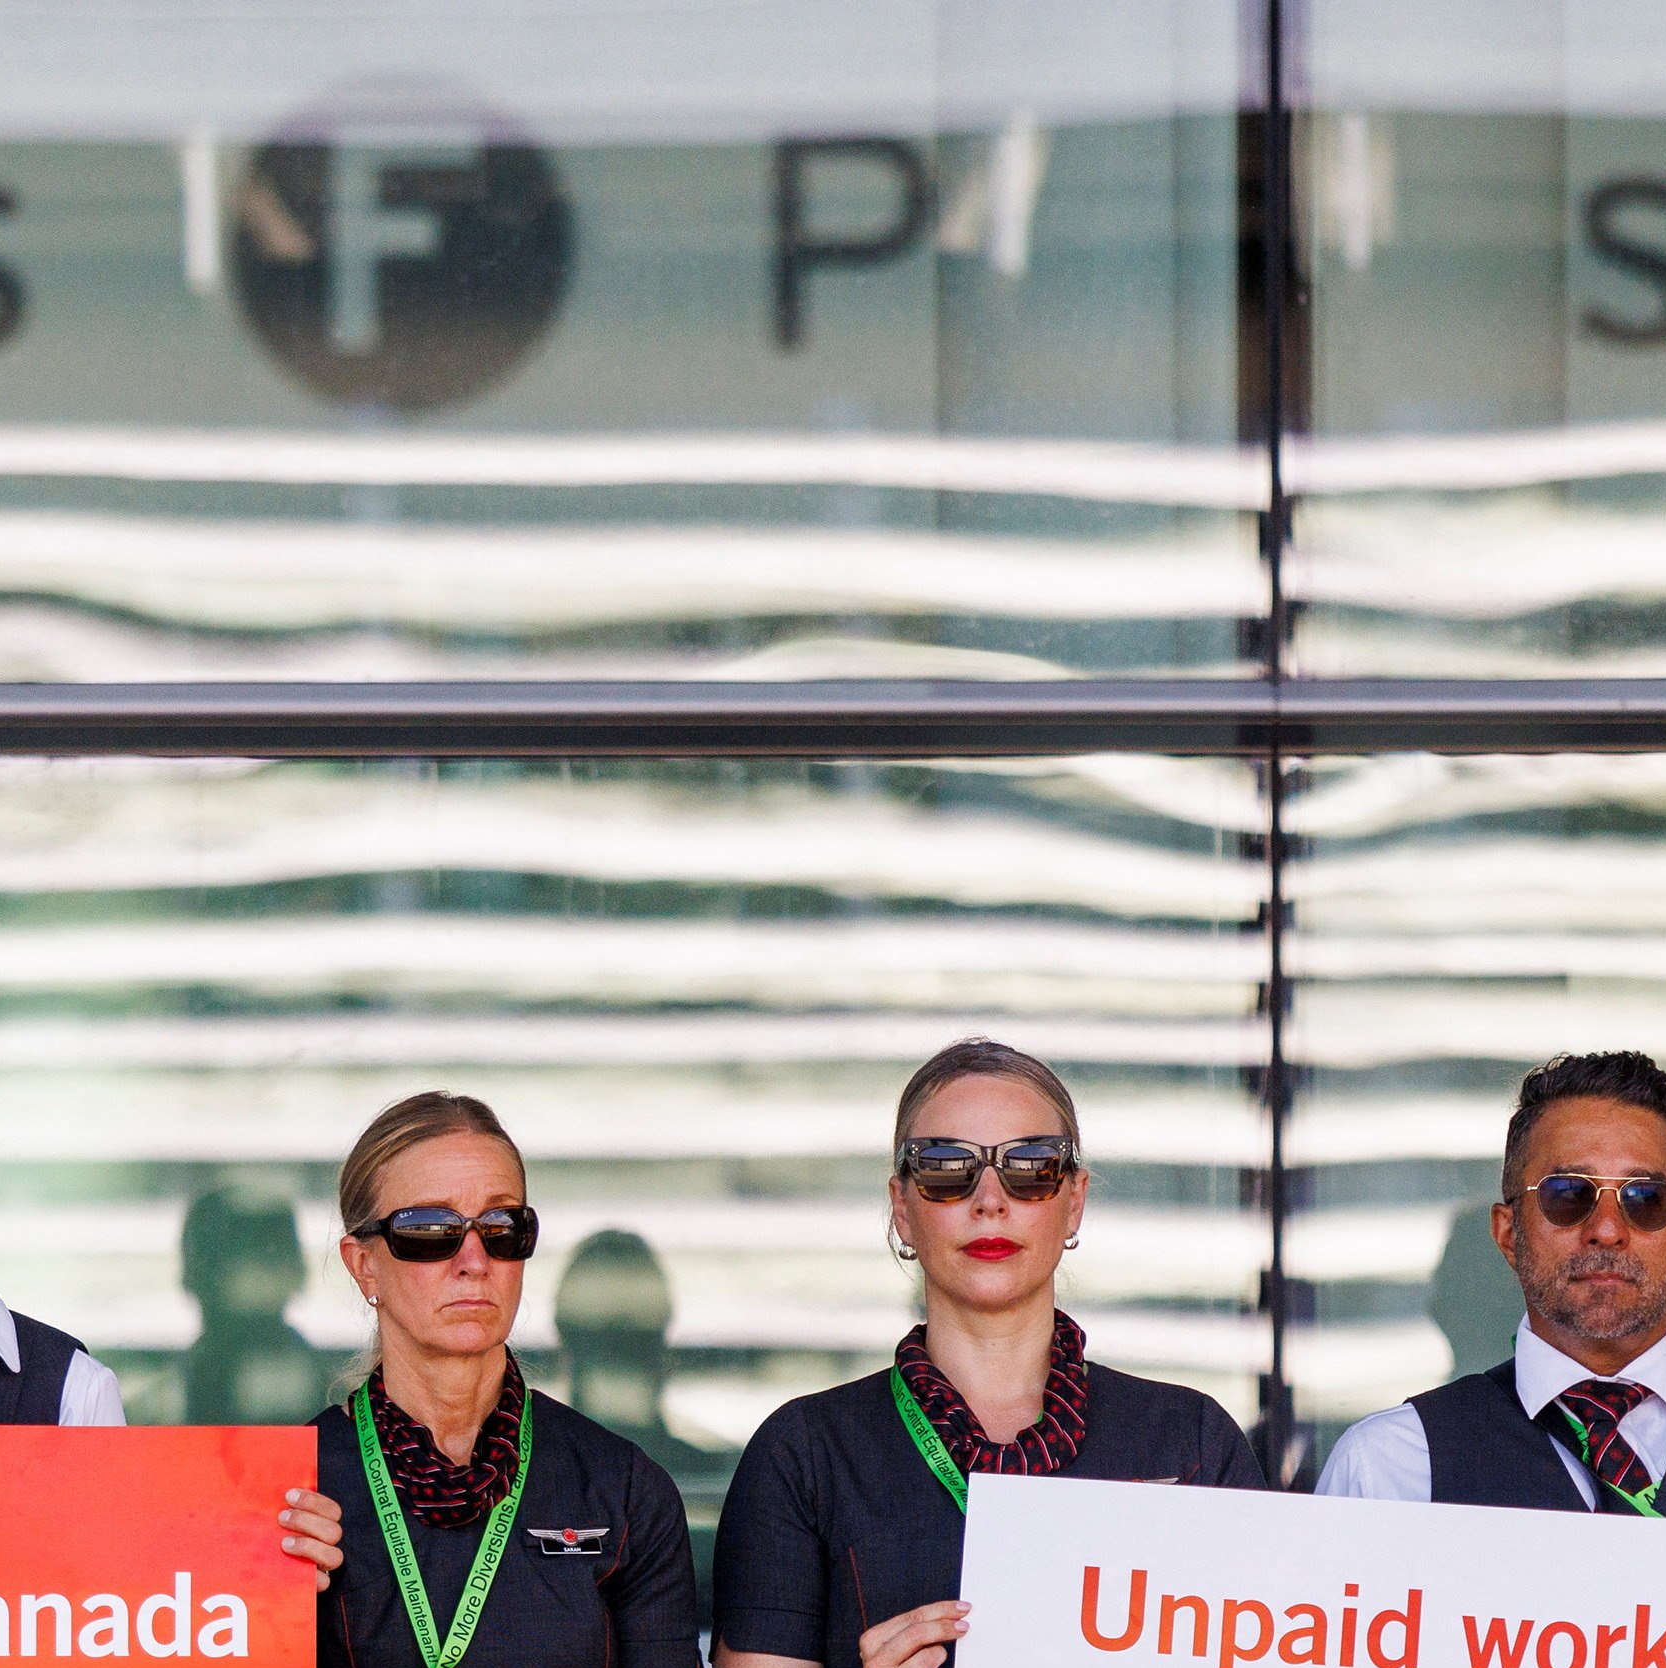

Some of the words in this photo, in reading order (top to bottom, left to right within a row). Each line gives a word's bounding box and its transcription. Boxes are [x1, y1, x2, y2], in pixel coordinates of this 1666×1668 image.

[364, 1436, 376, 1457] Un
[903, 1399, 929, 1439] Contrat
[922, 1436, 960, 1487] Équitable
[369, 1458, 392, 1511] Contrat
[384, 1512, 411, 1577] Équitable
[470, 1501, 515, 1595] Diversions.
[459, 1595, 482, 1643] More
